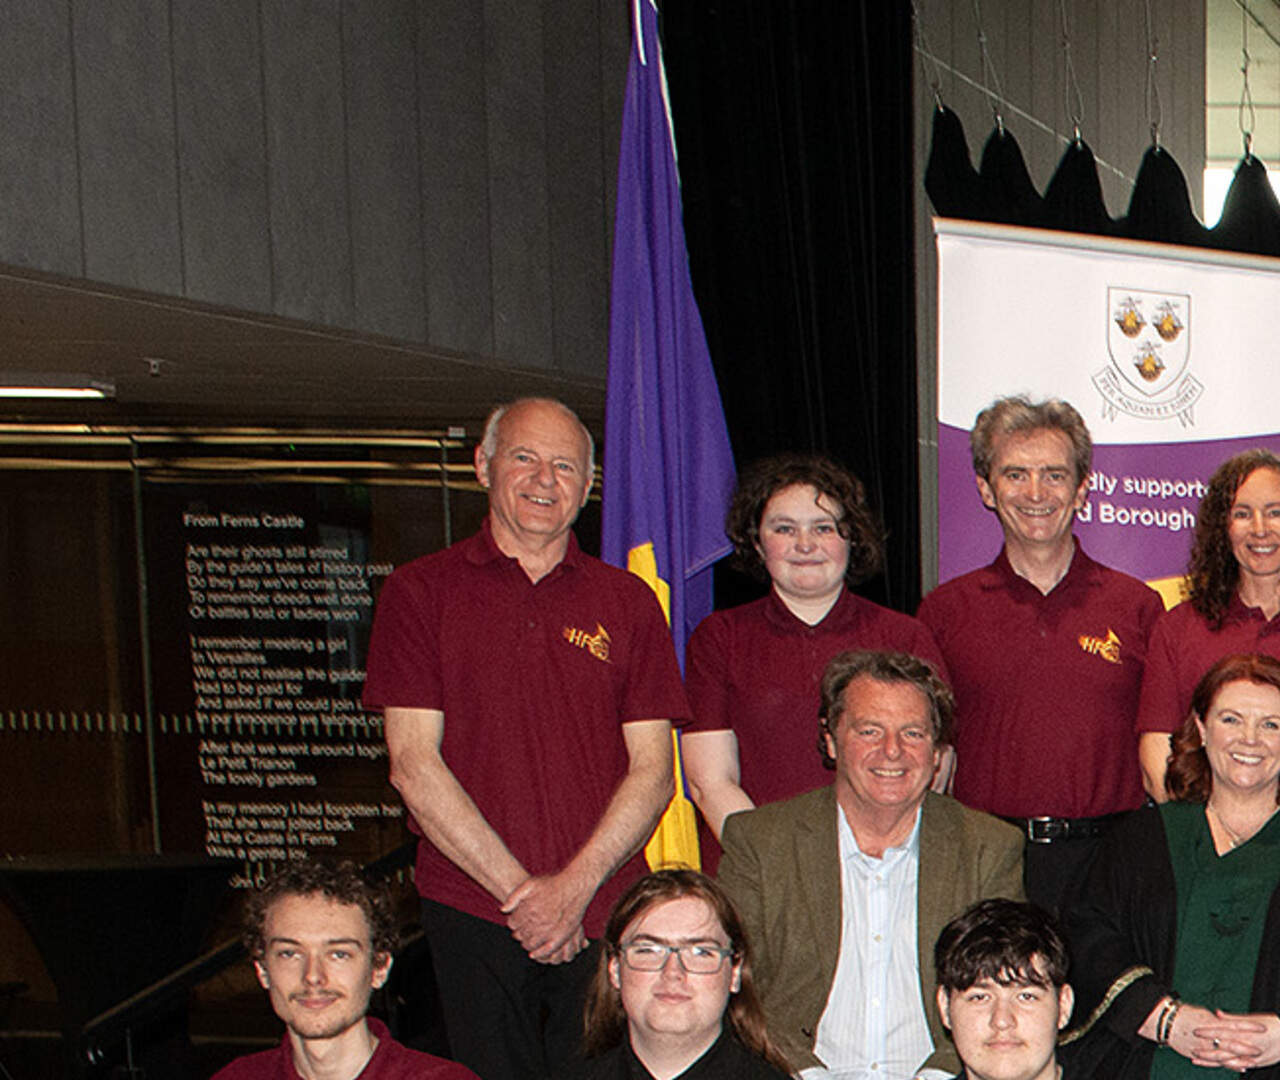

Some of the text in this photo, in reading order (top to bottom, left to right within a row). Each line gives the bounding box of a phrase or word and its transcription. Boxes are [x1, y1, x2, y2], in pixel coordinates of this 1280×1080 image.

[183, 513, 305, 529] From Ferns Castle
[1100, 502, 1195, 531] Borough
[187, 544, 348, 561] Are their ghosts still stirred
[186, 560, 395, 577] By the guide's tales of history past
[187, 576, 206, 589] Do
[208, 576, 236, 592] they
[238, 578, 261, 592] say
[301, 580, 336, 591] come
[338, 578, 370, 591] back
[189, 591, 373, 606] To remember deeds well done
[189, 605, 359, 621] Or battles lost or ladies won
[198, 635, 262, 650] remember
[263, 635, 314, 652] meeting
[326, 636, 347, 653] girl
[191, 650, 267, 665] In Versailles
[193, 666, 216, 680] We
[218, 666, 238, 681] did
[240, 667, 260, 681] not
[306, 667, 327, 682] the
[193, 680, 303, 697] Had to be paid for
[196, 695, 222, 710] And
[225, 696, 262, 711] asked
[264, 697, 273, 711] if
[274, 700, 294, 711] we
[296, 698, 330, 712] could
[331, 698, 355, 713] join
[199, 739, 229, 754] After
[231, 741, 255, 755] that
[257, 743, 276, 755] we
[278, 743, 310, 756] went
[311, 742, 354, 757] around
[199, 756, 297, 772] Le Petit Trianon
[200, 771, 318, 788] The lovely gardens
[202, 800, 215, 815] In
[218, 803, 237, 818] my
[238, 802, 289, 818] memory
[299, 803, 323, 817] had
[324, 803, 380, 820] forgotten
[235, 817, 258, 831] she
[261, 819, 286, 832] was
[287, 817, 323, 833] jolted
[324, 817, 355, 832] back
[205, 832, 338, 847] At the Castle in Ferns
